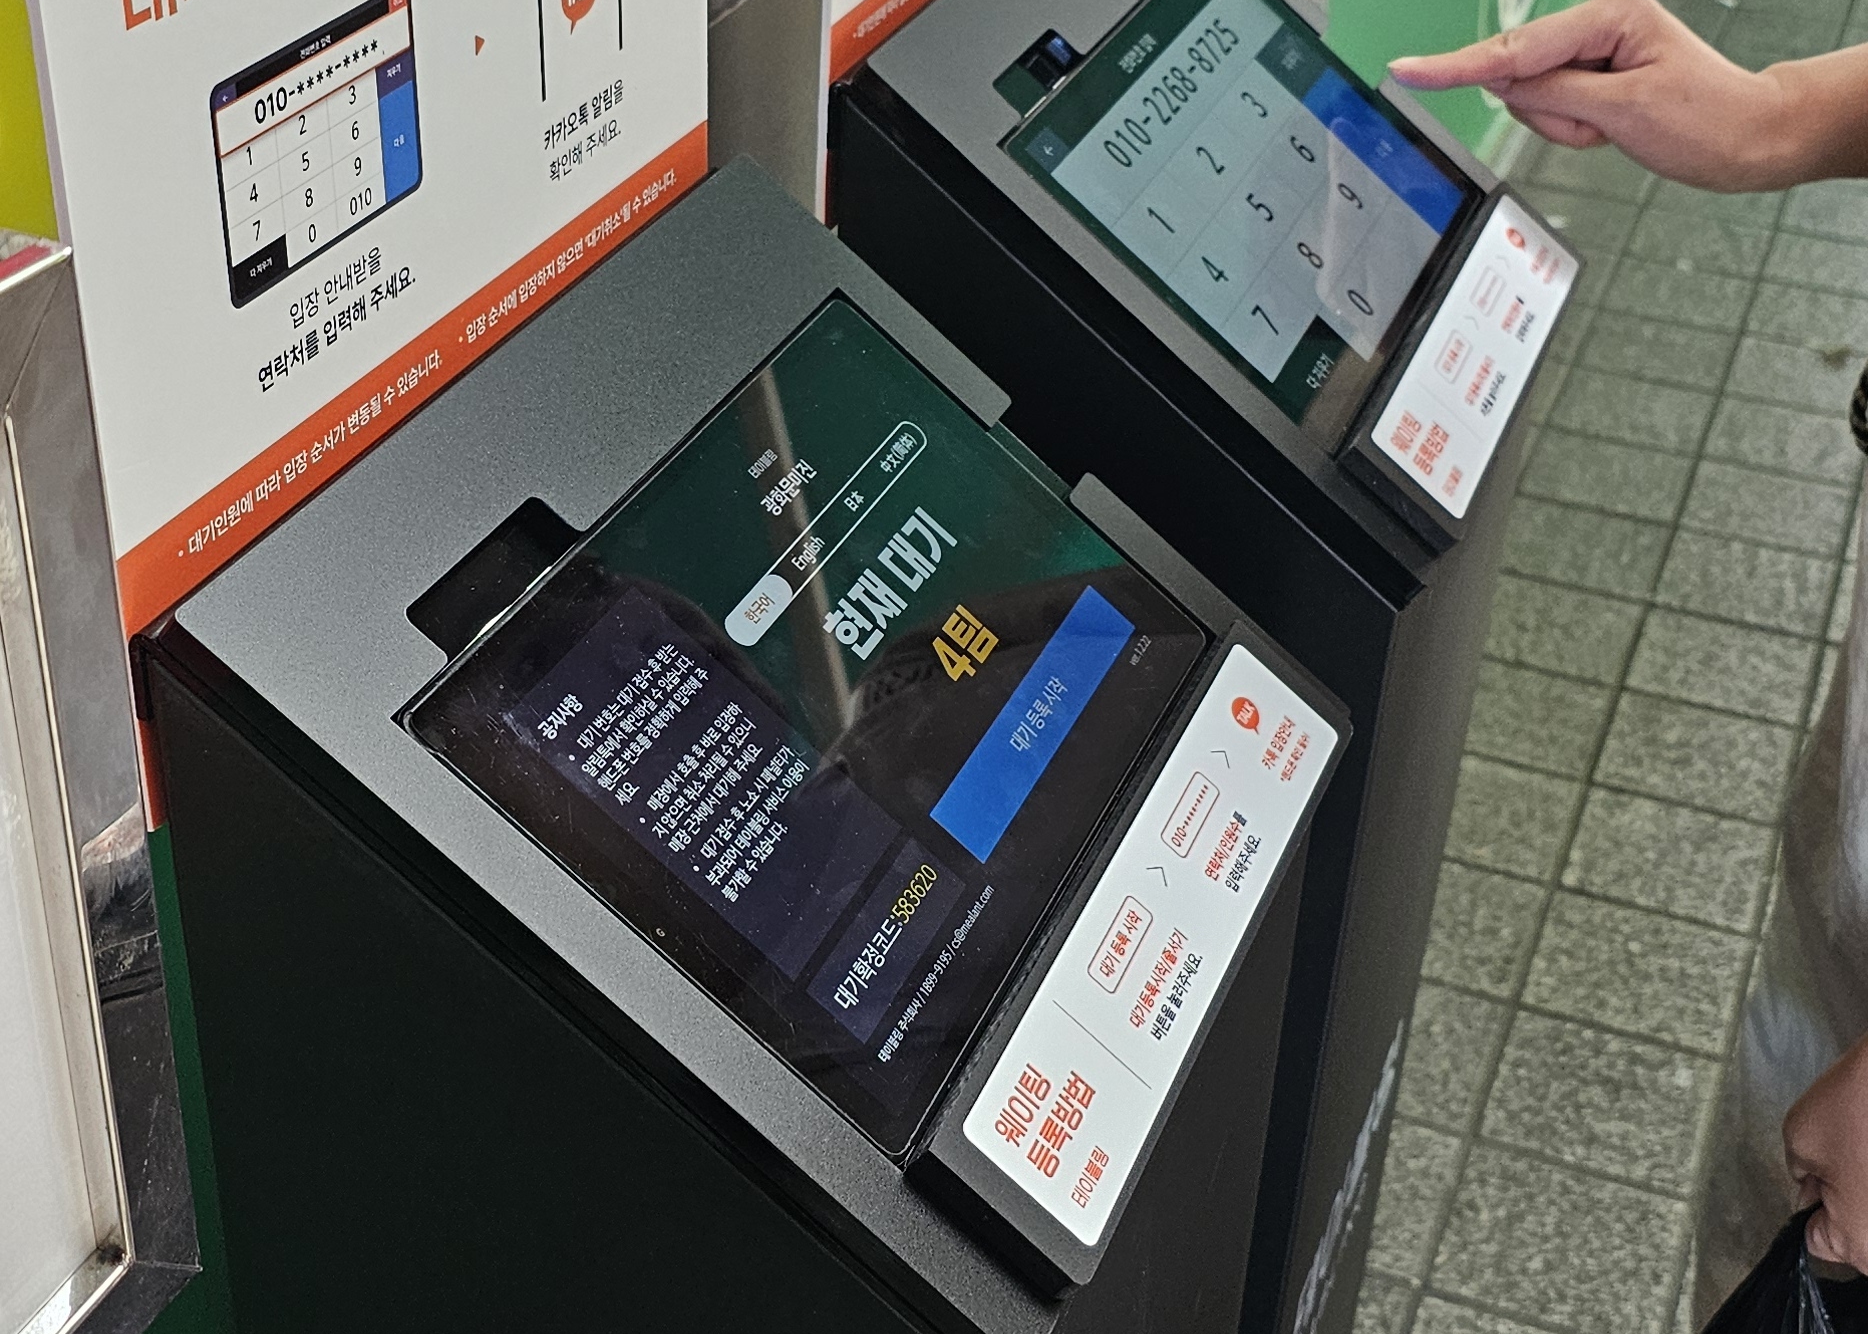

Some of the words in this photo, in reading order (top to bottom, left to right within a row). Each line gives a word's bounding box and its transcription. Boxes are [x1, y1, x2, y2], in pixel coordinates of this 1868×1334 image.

[348, 85, 357, 105] 3
[1103, 18, 1240, 169] 010-2268-8725
[1241, 91, 1268, 118] 3
[298, 114, 307, 135] 2
[351, 120, 360, 141] 6
[544, 101, 590, 150] 카카오톡
[591, 78, 624, 121] 알림을
[245, 145, 254, 166] 1
[302, 151, 311, 172] 5
[354, 156, 362, 177] 9
[549, 140, 583, 182] 확인해
[585, 118, 622, 158] 주세요.
[1196, 146, 1225, 175] 2
[1290, 135, 1316, 163] 6
[249, 183, 259, 203] 4
[304, 188, 313, 208] 8
[349, 187, 373, 217] 010
[1245, 193, 1274, 222] 5
[1337, 182, 1364, 209] 9
[252, 220, 261, 242] 7
[308, 223, 317, 243] 0
[1147, 207, 1175, 234] 1
[466, 315, 487, 343] 입장
[488, 288, 518, 328] 순서에
[518, 260, 556, 303] 입장하지
[556, 237, 585, 272] 않으면
[632, 195, 642, 214] 수
[643, 168, 678, 208] 있습니다.
[1201, 256, 1229, 283] 4
[1296, 241, 1324, 269] 8
[289, 287, 320, 329] 입장
[323, 246, 382, 306] 안내받을
[1347, 289, 1374, 316] 0
[257, 329, 320, 393] 연락처를
[323, 294, 367, 347] 입력해
[370, 266, 416, 312] 주세요.
[1251, 305, 1279, 336] 7
[187, 489, 254, 555] 대기인원에
[254, 470, 281, 501] 따라
[282, 451, 308, 484] 입장
[309, 421, 346, 464] 순서가
[346, 393, 382, 435] 변동될
[382, 385, 396, 406] 수
[396, 349, 444, 399] 있습니다.
[747, 448, 778, 478] 테이블링
[760, 458, 817, 515] 광화문미진
[843, 490, 864, 511] 日本
[791, 535, 825, 570] English
[822, 568, 908, 660] 현재
[877, 505, 957, 592] 대기
[744, 593, 776, 624] 한국어
[932, 603, 999, 681] 4팀
[576, 724, 602, 748] 대기
[592, 702, 624, 731] 번호는
[616, 682, 640, 705] 대기
[631, 668, 653, 689] 접수
[647, 658, 661, 672] 후
[654, 643, 678, 664] 받는
[1236, 701, 1255, 725] TALK
[537, 693, 583, 739] 공지사항
[581, 727, 628, 777] 알림톡에서
[619, 694, 658, 733] 확인하실
[650, 687, 664, 700] 수
[657, 654, 694, 692] 있습니다.
[620, 732, 652, 764] 번호를
[643, 698, 681, 738] 정확하게
[672, 674, 702, 706] 입력해
[694, 667, 708, 680] 주
[1009, 720, 1037, 751] 대기
[1025, 698, 1053, 729] 등록
[1042, 676, 1068, 705] 시작
[1270, 715, 1295, 752] 입장안내
[646, 770, 684, 810] 매장에서
[676, 754, 699, 777] 호출
[691, 744, 705, 758] 후
[699, 726, 721, 747] 바로
[713, 701, 742, 732] 입장하
[760, 744, 795, 782] 페널티가
[651, 821, 669, 838] 지
[660, 794, 692, 829] 않으면
[682, 779, 705, 800] 취소
[697, 750, 728, 782] 처리될
[720, 743, 734, 756] 수
[727, 716, 756, 748] 있으니
[753, 777, 768, 792] 시
[667, 827, 691, 852] 매장
[683, 792, 721, 835] 근처에서
[712, 766, 741, 798] 대기해
[730, 806, 744, 821] 후
[738, 790, 760, 811] 노쇼
[705, 843, 743, 885] 부과되어
[734, 808, 769, 849] 테이블링
[762, 786, 789, 814] 서비스
[781, 758, 810, 787] 이용이
[714, 818, 736, 841] 접수
[699, 833, 724, 858] 대기
[751, 821, 787, 863] 있습니다.
[1204, 810, 1247, 881] 연락처/인원수를
[745, 858, 758, 871] 수
[1225, 834, 1261, 892] 입력해주세요.
[1099, 950, 1120, 977] 대기
[1110, 930, 1131, 955] 등록
[1122, 909, 1142, 934] 시작
[877, 1027, 903, 1062] 테이블링
[897, 998, 922, 1030] 주식회사
[919, 949, 952, 996] 1899-9195
[951, 884, 994, 948] cs@mealant.com
[1129, 927, 1188, 1027] 대기등록시작/줄서기
[1150, 1003, 1176, 1040] 버튼을
[1166, 953, 1203, 1008] 눌러주세요.
[994, 1062, 1051, 1147] 웨이팅
[1026, 1070, 1096, 1177] 등록방법
[1071, 1145, 1109, 1208] 테이블링
